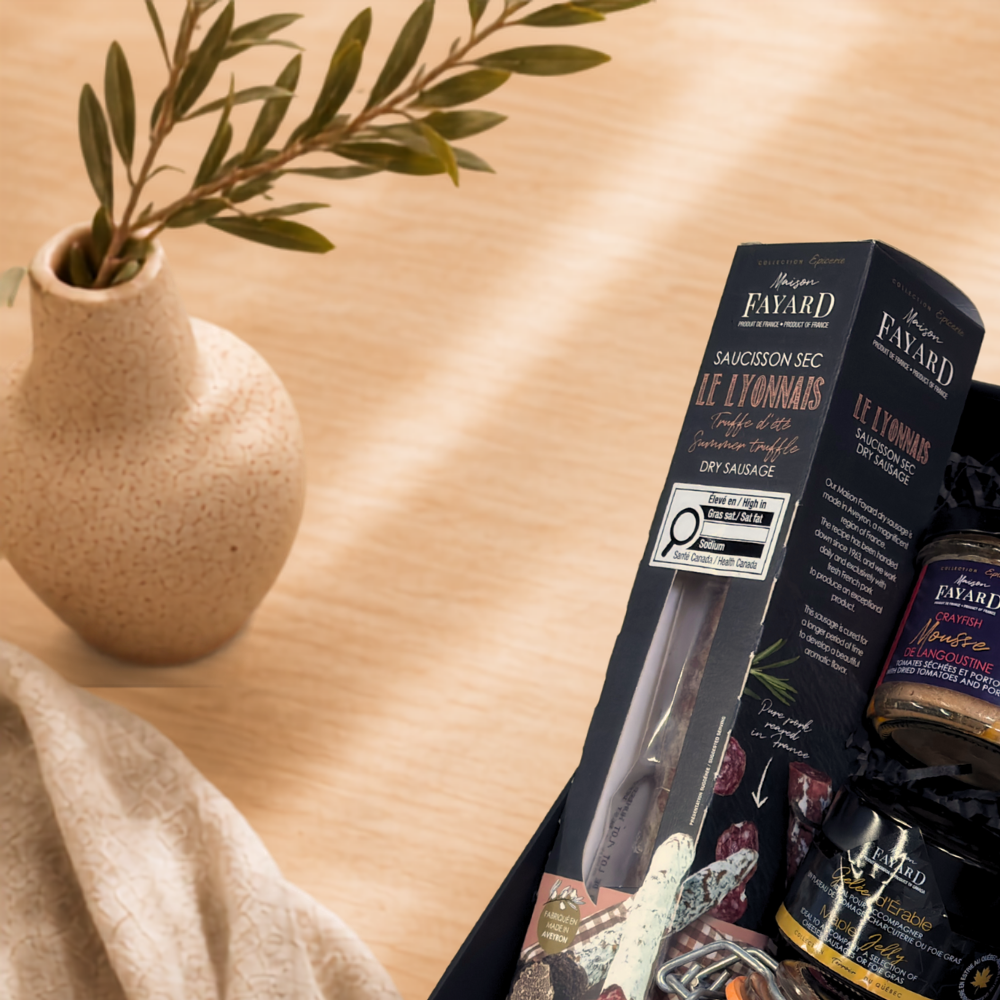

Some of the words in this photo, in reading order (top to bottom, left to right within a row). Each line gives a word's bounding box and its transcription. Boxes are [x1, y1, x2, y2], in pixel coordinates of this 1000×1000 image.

[769, 272, 820, 291] Maison
[741, 292, 835, 318] FAYARD
[903, 307, 944, 343] Maison
[714, 351, 793, 368] SAUCISSON
[794, 352, 823, 368] SEC
[876, 311, 954, 387] FAYARD
[695, 373, 723, 407] LE
[724, 373, 825, 411] LYONNAIS
[710, 411, 753, 437] Truffe
[853, 393, 872, 424] LE
[871, 406, 931, 465] LYONNAIS
[688, 430, 746, 453] Summer
[749, 438, 799, 463] truffle
[855, 428, 900, 464] SAUCISSON
[900, 459, 916, 475] SEC
[699, 460, 723, 473] DRY
[723, 461, 776, 478] SAUSAGE
[856, 443, 874, 460] DRY
[874, 455, 910, 485] SAUSAGE
[825, 478, 837, 490] Our
[858, 498, 878, 516] Fayard
[886, 518, 909, 536] sausage
[699, 539, 726, 551] Sodium
[832, 525, 850, 540] recipe
[691, 553, 713, 564] Canada
[736, 558, 758, 569] Canada
[816, 572, 842, 591] produce
[814, 612, 840, 630] sausage
[935, 612, 983, 629] CRAYFISH
[804, 647, 831, 666] aromatic
[806, 635, 830, 653] develop
[917, 648, 995, 674] LANGOUSTINE
[923, 660, 958, 674] SÉCHÉES
[970, 672, 1000, 687] PORTO
[916, 668, 958, 682] TOMATOES
[960, 678, 981, 689] AND
[758, 698, 785, 719] Pure
[783, 717, 813, 732] pork
[872, 847, 926, 886] FAYARD
[876, 896, 932, 932] d'Érable
[541, 931, 568, 943] AVEYRON
[860, 933, 908, 965] Jelly
[868, 917, 914, 944] CHARCUTERIE
[927, 946, 944, 958] FOIE
[943, 954, 962, 965] GRAS
[867, 961, 884, 975] FOIE
[884, 970, 905, 985] GRAS
[869, 954, 907, 976] SELECTION
